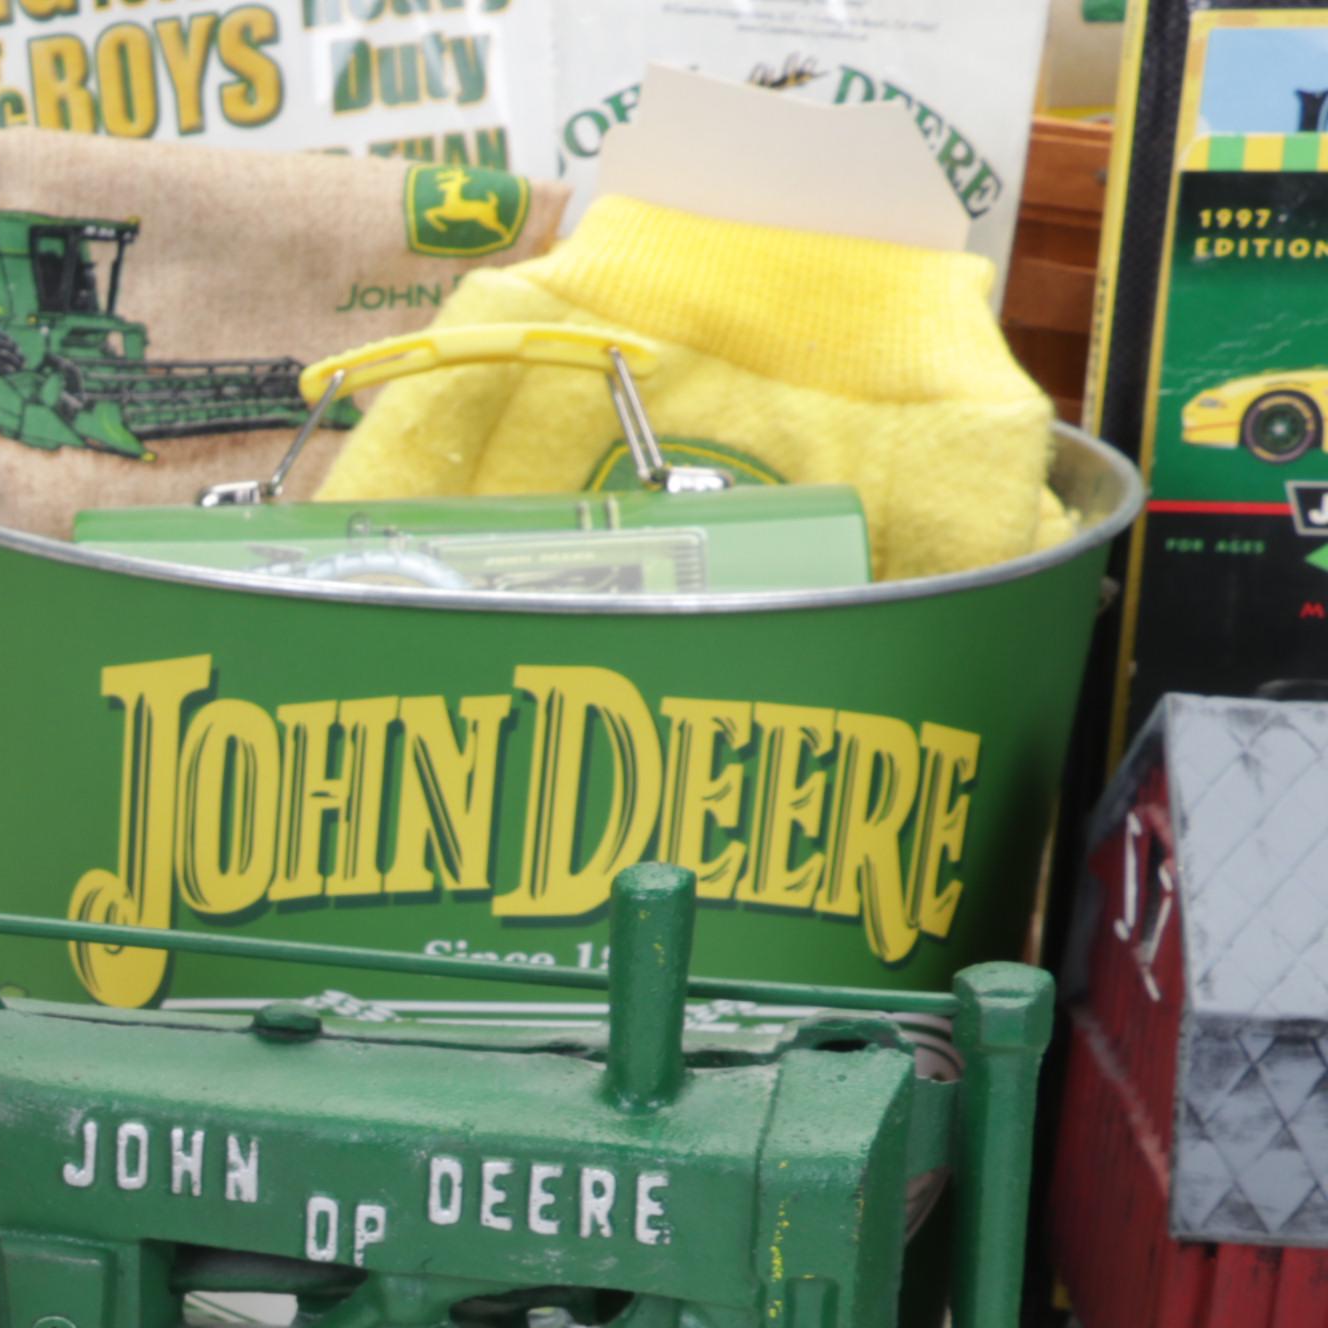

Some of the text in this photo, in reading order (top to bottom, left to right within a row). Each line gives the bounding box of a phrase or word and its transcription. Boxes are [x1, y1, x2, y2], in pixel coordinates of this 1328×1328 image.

[27, 3, 284, 139] BOYS
[1195, 237, 1328, 258] EDITION
[1199, 208, 1271, 228] 1997
[334, 283, 443, 314] JOHN
[66, 654, 981, 1008] JOHN DEERE
[62, 1120, 671, 1246] JOHN DEERE
[305, 1195, 386, 1265] OP
